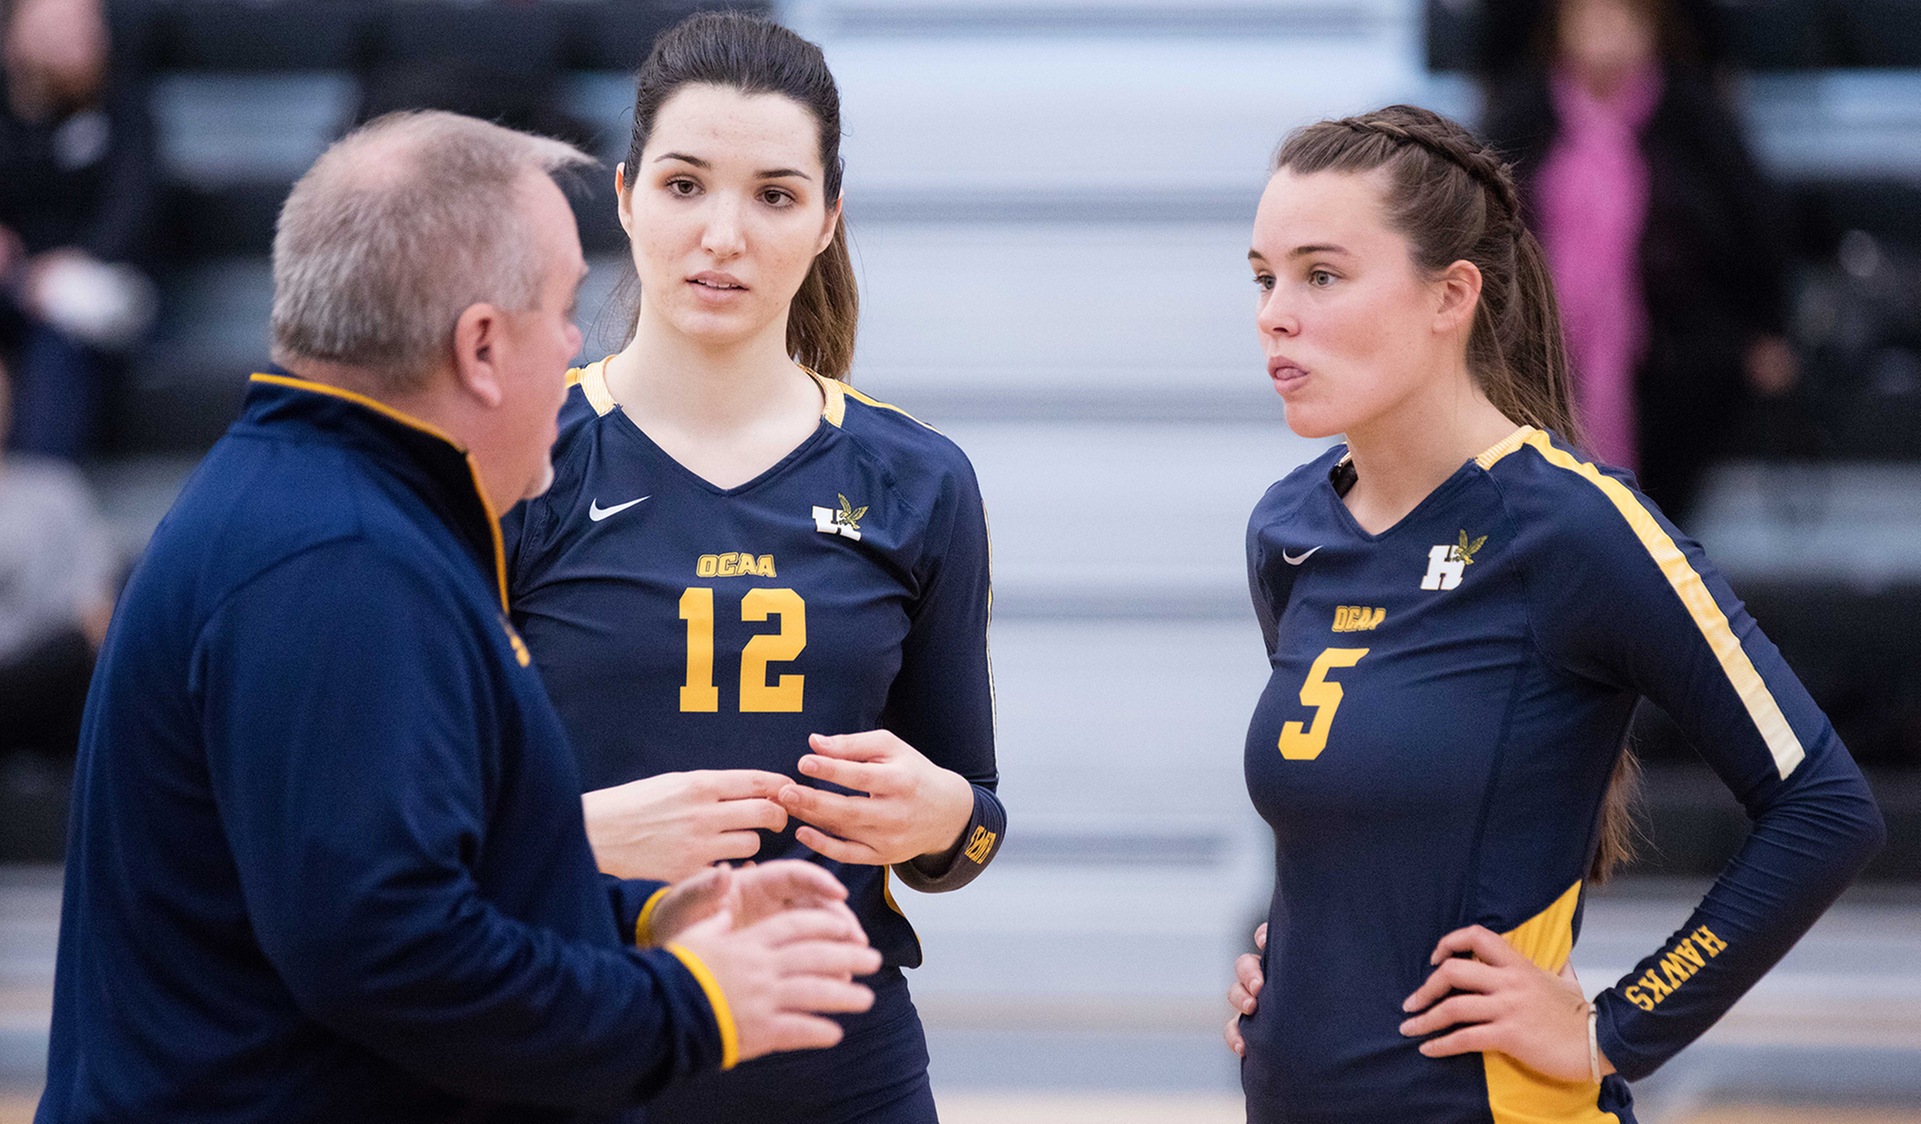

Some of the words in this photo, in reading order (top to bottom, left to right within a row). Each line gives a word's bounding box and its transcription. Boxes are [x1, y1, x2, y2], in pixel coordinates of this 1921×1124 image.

[696, 552, 777, 578] OCAA
[679, 587, 807, 713] 12
[1278, 648, 1370, 760] 5
[1625, 924, 1728, 1011] HAWKS
